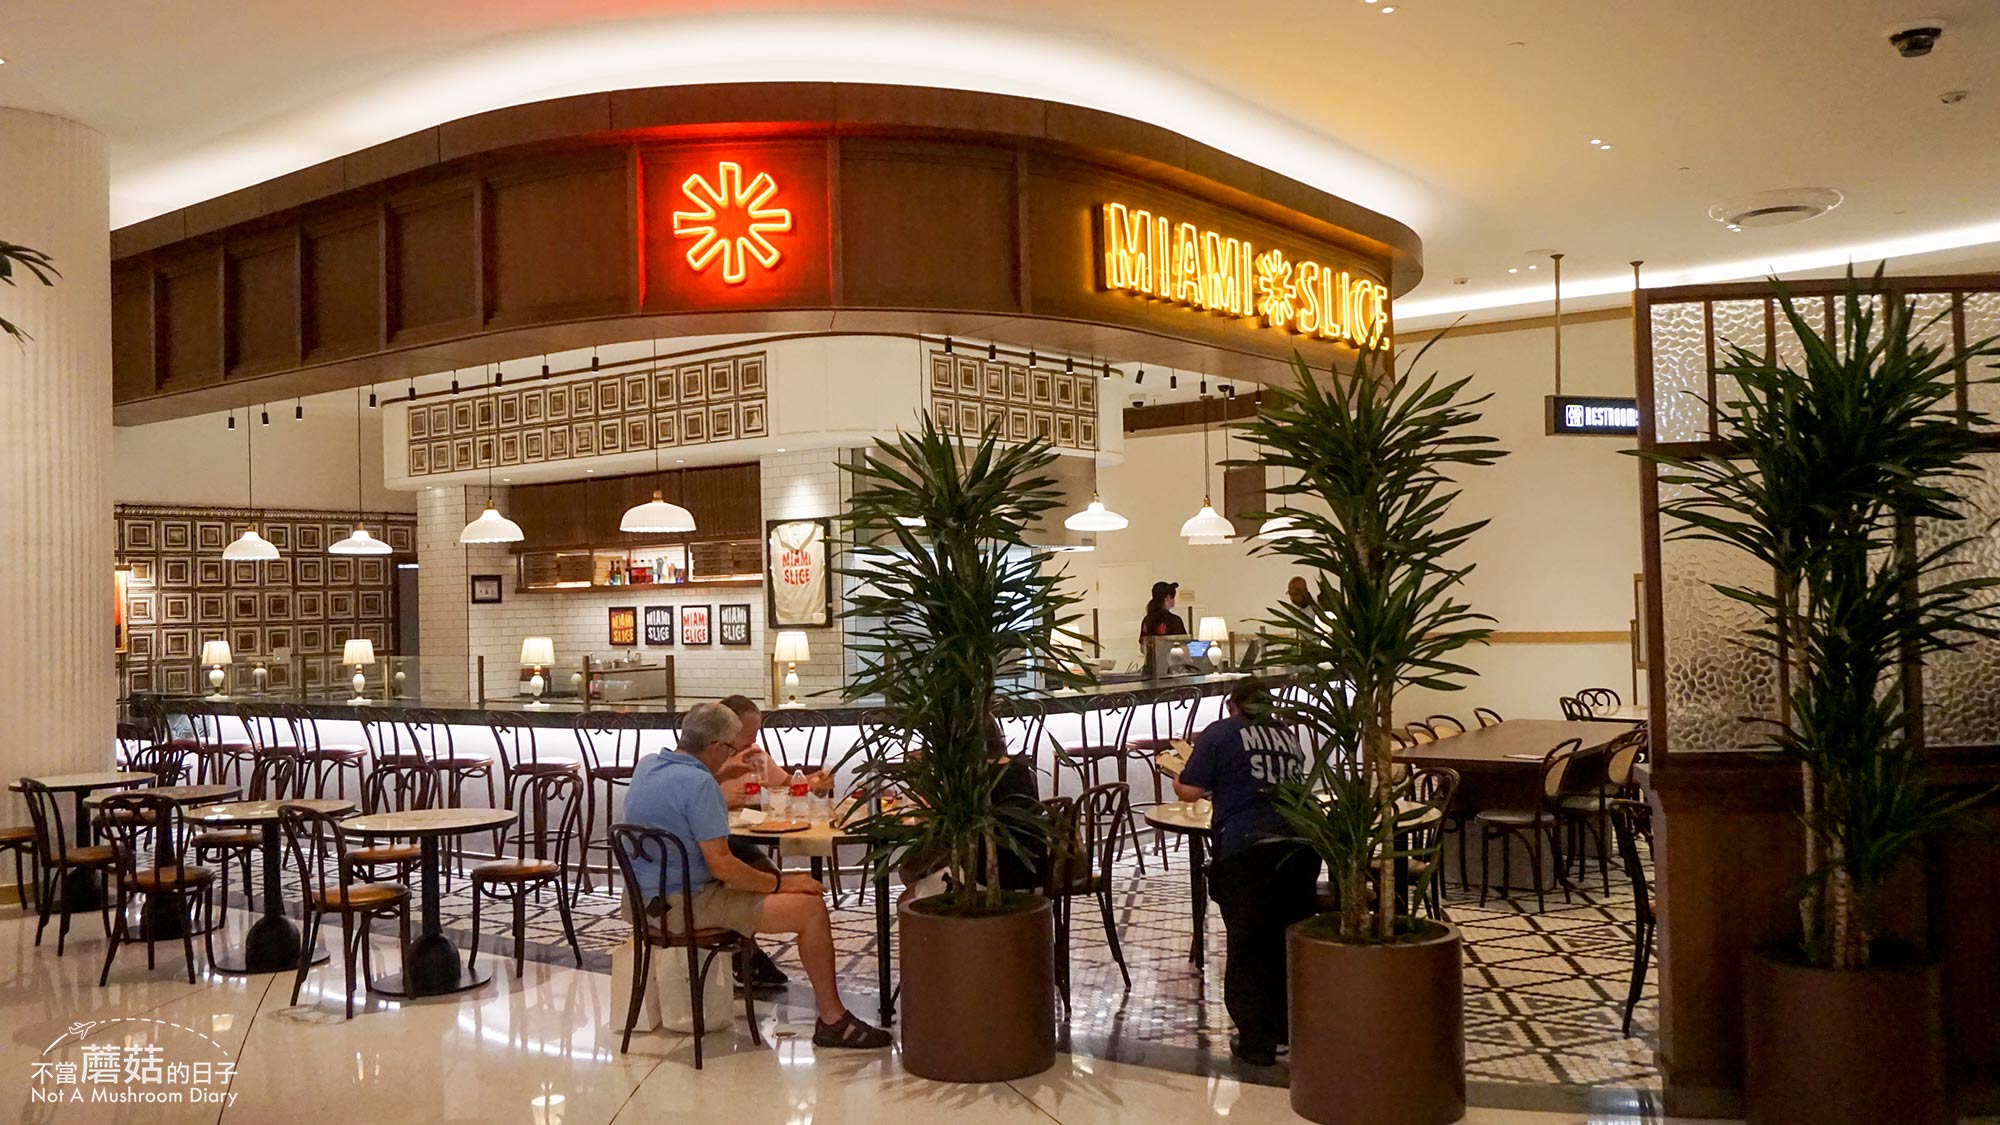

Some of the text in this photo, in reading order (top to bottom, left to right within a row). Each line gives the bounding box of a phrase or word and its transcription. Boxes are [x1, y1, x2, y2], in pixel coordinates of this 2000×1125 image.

[1103, 202, 1390, 351] MIAMI SLICE
[783, 549, 811, 567] MIAMI
[784, 568, 810, 585] SLICE
[646, 609, 671, 626] MIAMI
[683, 611, 707, 627] MIAMI
[721, 607, 747, 624] MIAMI
[648, 626, 670, 641] SLICE
[685, 628, 706, 643] SLICE
[722, 624, 746, 641] SLICE
